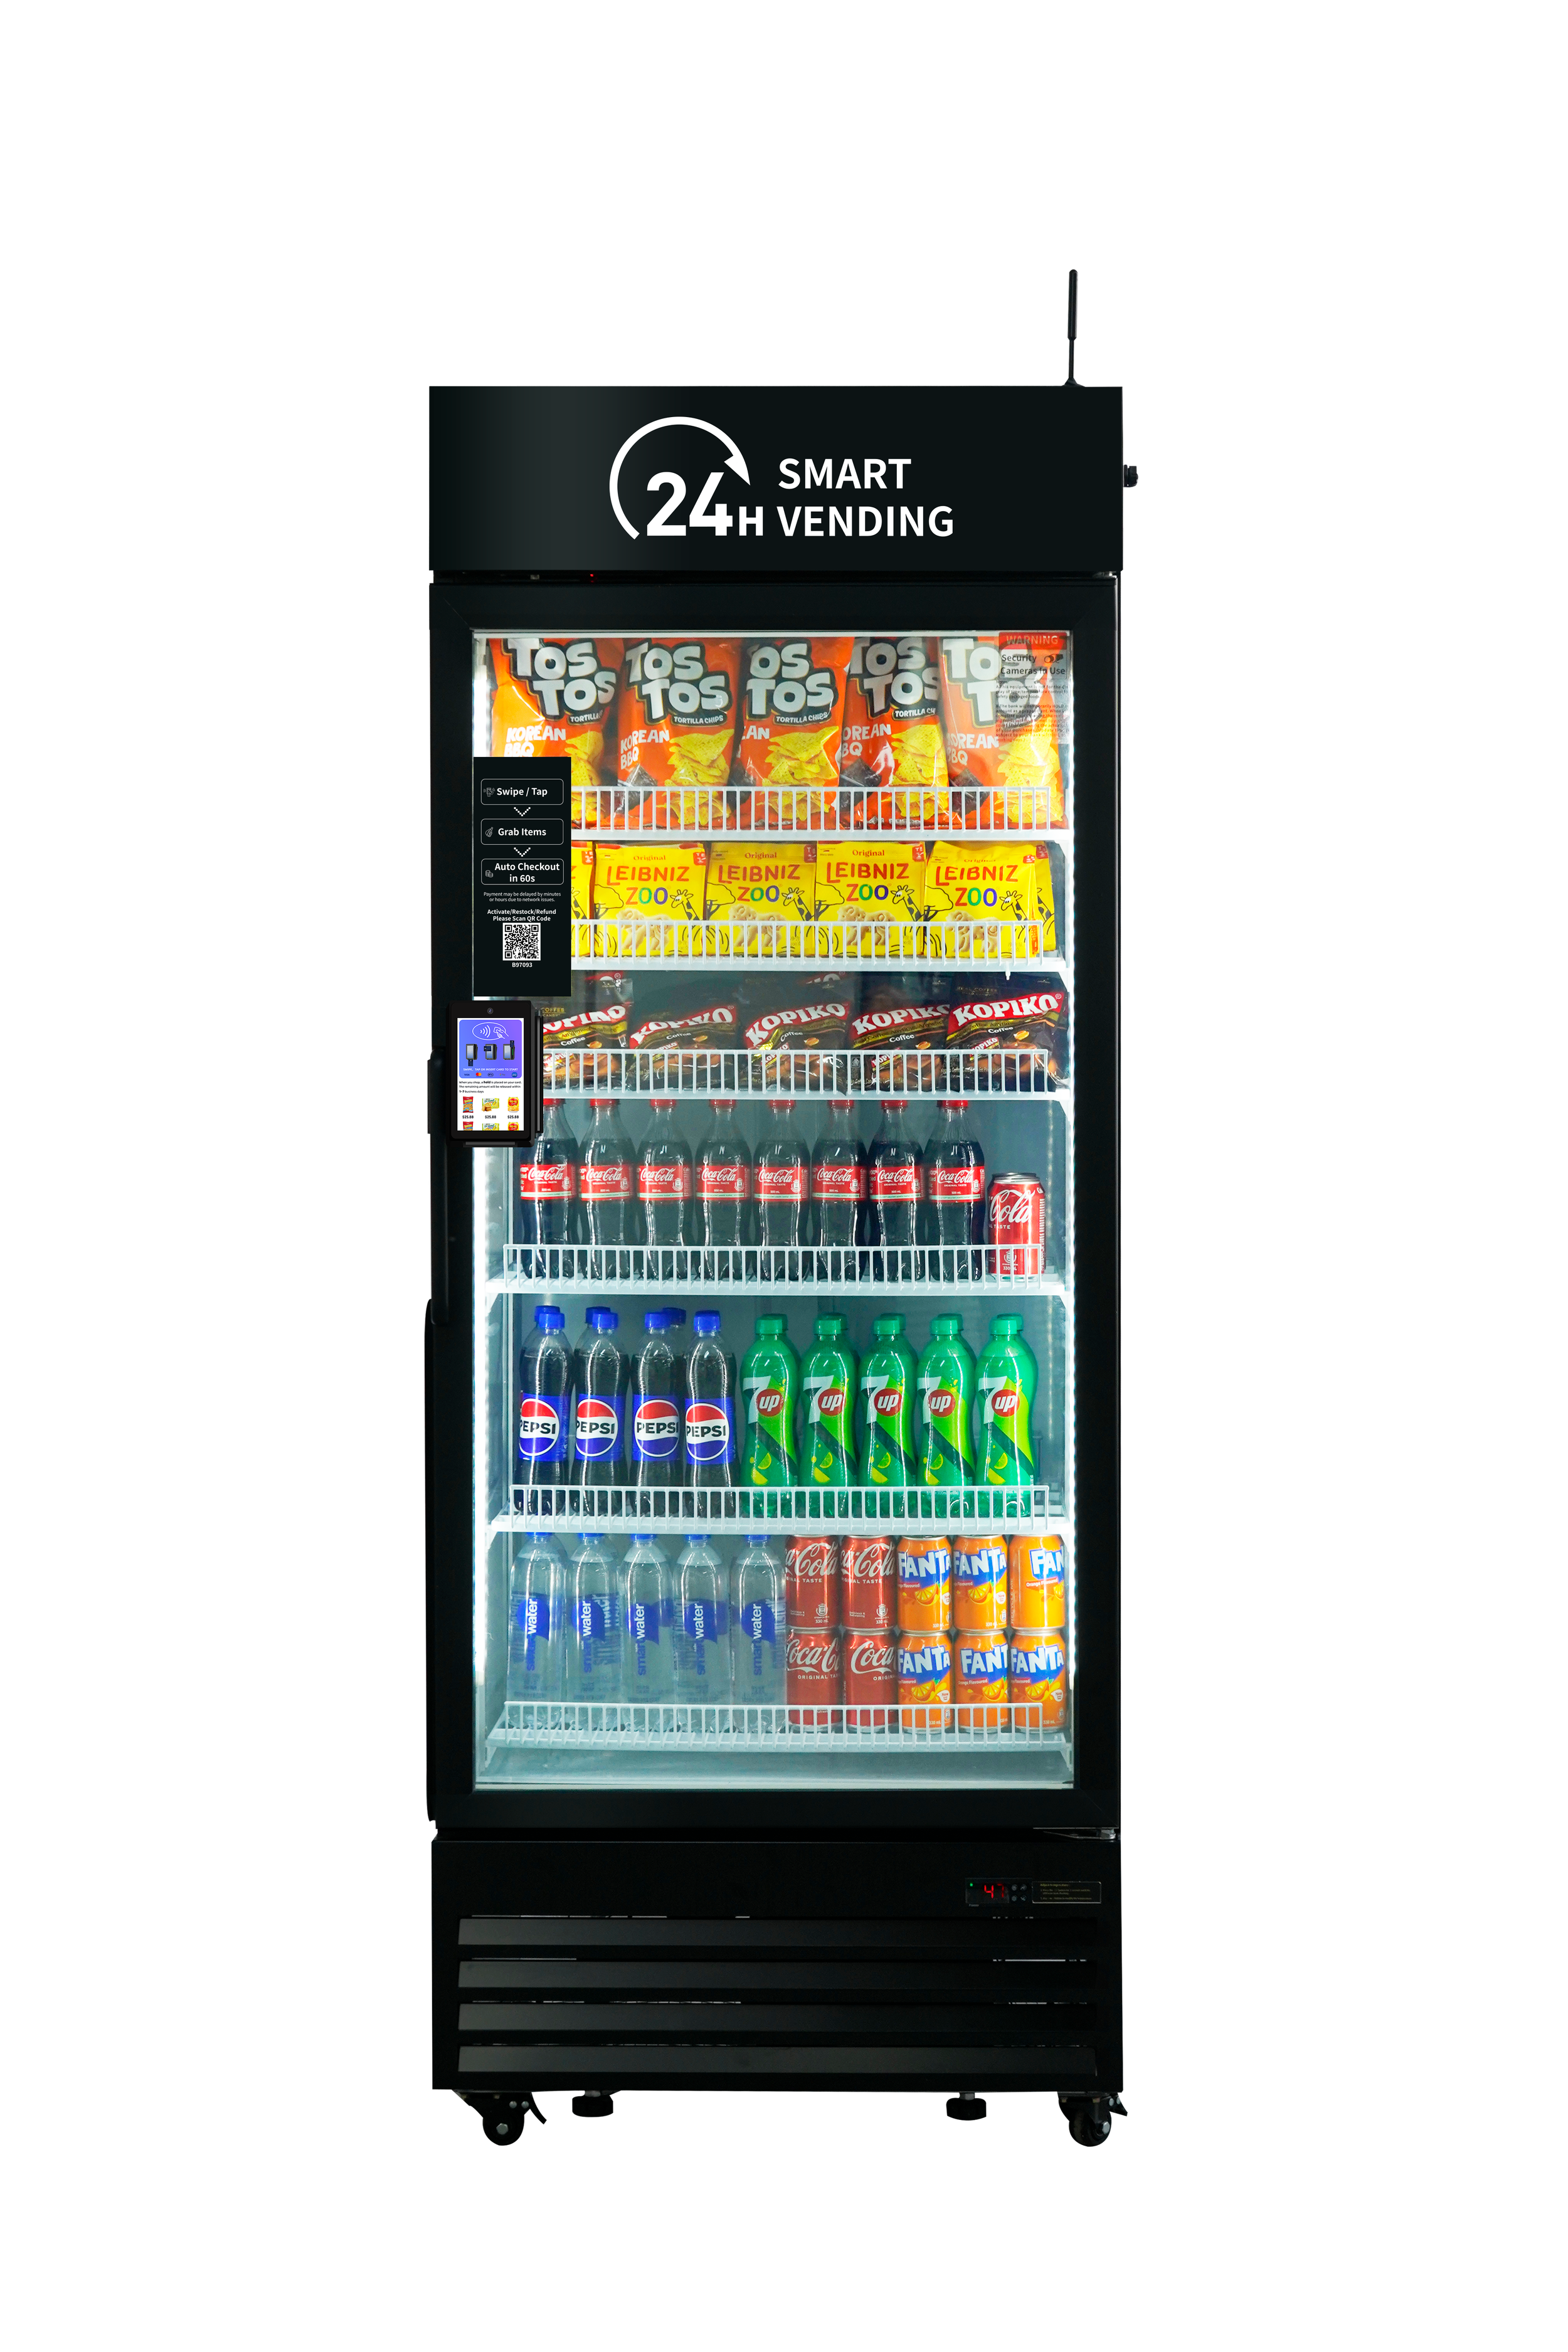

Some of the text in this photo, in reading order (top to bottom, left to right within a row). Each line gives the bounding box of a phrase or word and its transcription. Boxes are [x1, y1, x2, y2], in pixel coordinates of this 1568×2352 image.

[778, 458, 912, 490] SMART
[776, 506, 953, 537] VENDING
[1006, 635, 1058, 645] WARNING
[507, 638, 598, 680] TOS
[626, 641, 704, 682] TOS
[850, 637, 926, 675] TOS
[1002, 654, 1037, 664] Security
[533, 670, 617, 716] TOS
[642, 673, 729, 720] TOS
[746, 672, 834, 715] TOS
[864, 667, 941, 714] TOS
[674, 714, 724, 724] TORTILLA CHIPS
[808, 712, 828, 721] CHIPS
[894, 708, 926, 718] TORTILLA
[506, 725, 566, 743] KOREAN
[842, 723, 892, 741] OREAN
[504, 741, 535, 757] BBQ
[620, 729, 670, 755] KOREAN
[620, 746, 639, 770] BBQ
[496, 787, 548, 797] Swipe / Tap
[497, 827, 547, 836] Grab Items
[744, 852, 777, 860] Original
[852, 849, 885, 857] Original
[494, 862, 560, 871] Auto Checkout
[718, 864, 801, 884] LEIBNIZ
[827, 862, 909, 884] LEIBNIZ
[509, 874, 536, 882] in 60s
[607, 866, 690, 886] LEIBNIZ
[935, 864, 1019, 886] LEIBNIZ
[625, 886, 669, 905] ZOO
[737, 885, 780, 903] ZOO
[846, 883, 889, 902] ZOO
[955, 887, 998, 907] ZOO
[953, 994, 1059, 1027] KOPIKO
[745, 1003, 846, 1047] KOPIKO
[560, 1037, 586, 1046] Coffee
[780, 1032, 803, 1042] Coffee
[889, 1034, 915, 1042] Coffee
[527, 1167, 566, 1181] Coca-Cola
[586, 1167, 623, 1182] Coca-Cola
[640, 1168, 676, 1182] Coca-Cola
[702, 1167, 739, 1182] Coca-Cola
[758, 1169, 795, 1183] Coca-Cola
[817, 1168, 854, 1182] Coca-Cola
[877, 1168, 914, 1183] Coca-Cola
[937, 1169, 975, 1184] Coca-Cola
[519, 1421, 556, 1435] PEPSI
[576, 1420, 615, 1434] PEPSI
[637, 1421, 679, 1434] PEPSI
[687, 1424, 726, 1438] PEPSI
[898, 1549, 951, 1578] FANTA
[953, 1548, 1007, 1576] FANTA
[898, 1646, 950, 1673] FANTA
[1011, 1646, 1064, 1673] FANTA
[983, 1883, 1004, 1899] 47
